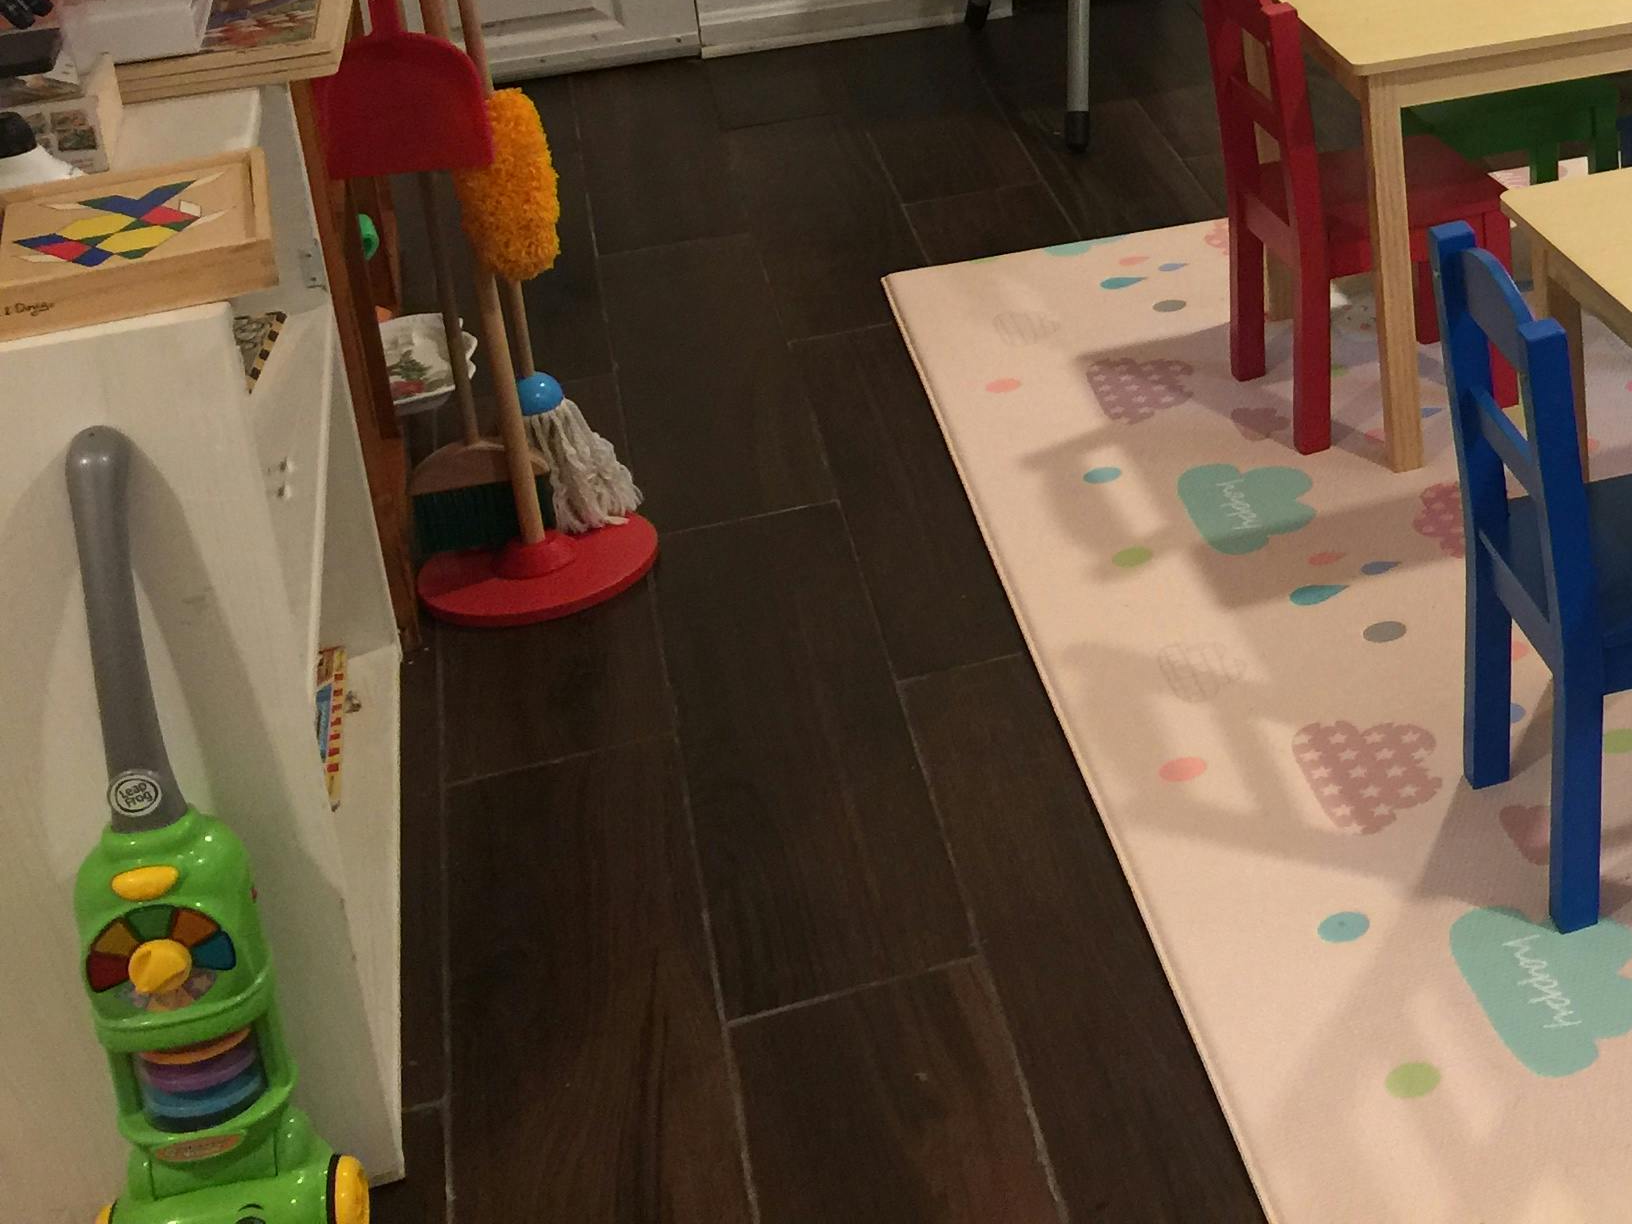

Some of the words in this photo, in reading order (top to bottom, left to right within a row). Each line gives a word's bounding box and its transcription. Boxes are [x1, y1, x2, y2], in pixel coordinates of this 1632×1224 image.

[1216, 479, 1262, 530] happy
[119, 782, 147, 799] Leap
[125, 791, 153, 808] Frog
[1502, 934, 1583, 1028] happy
